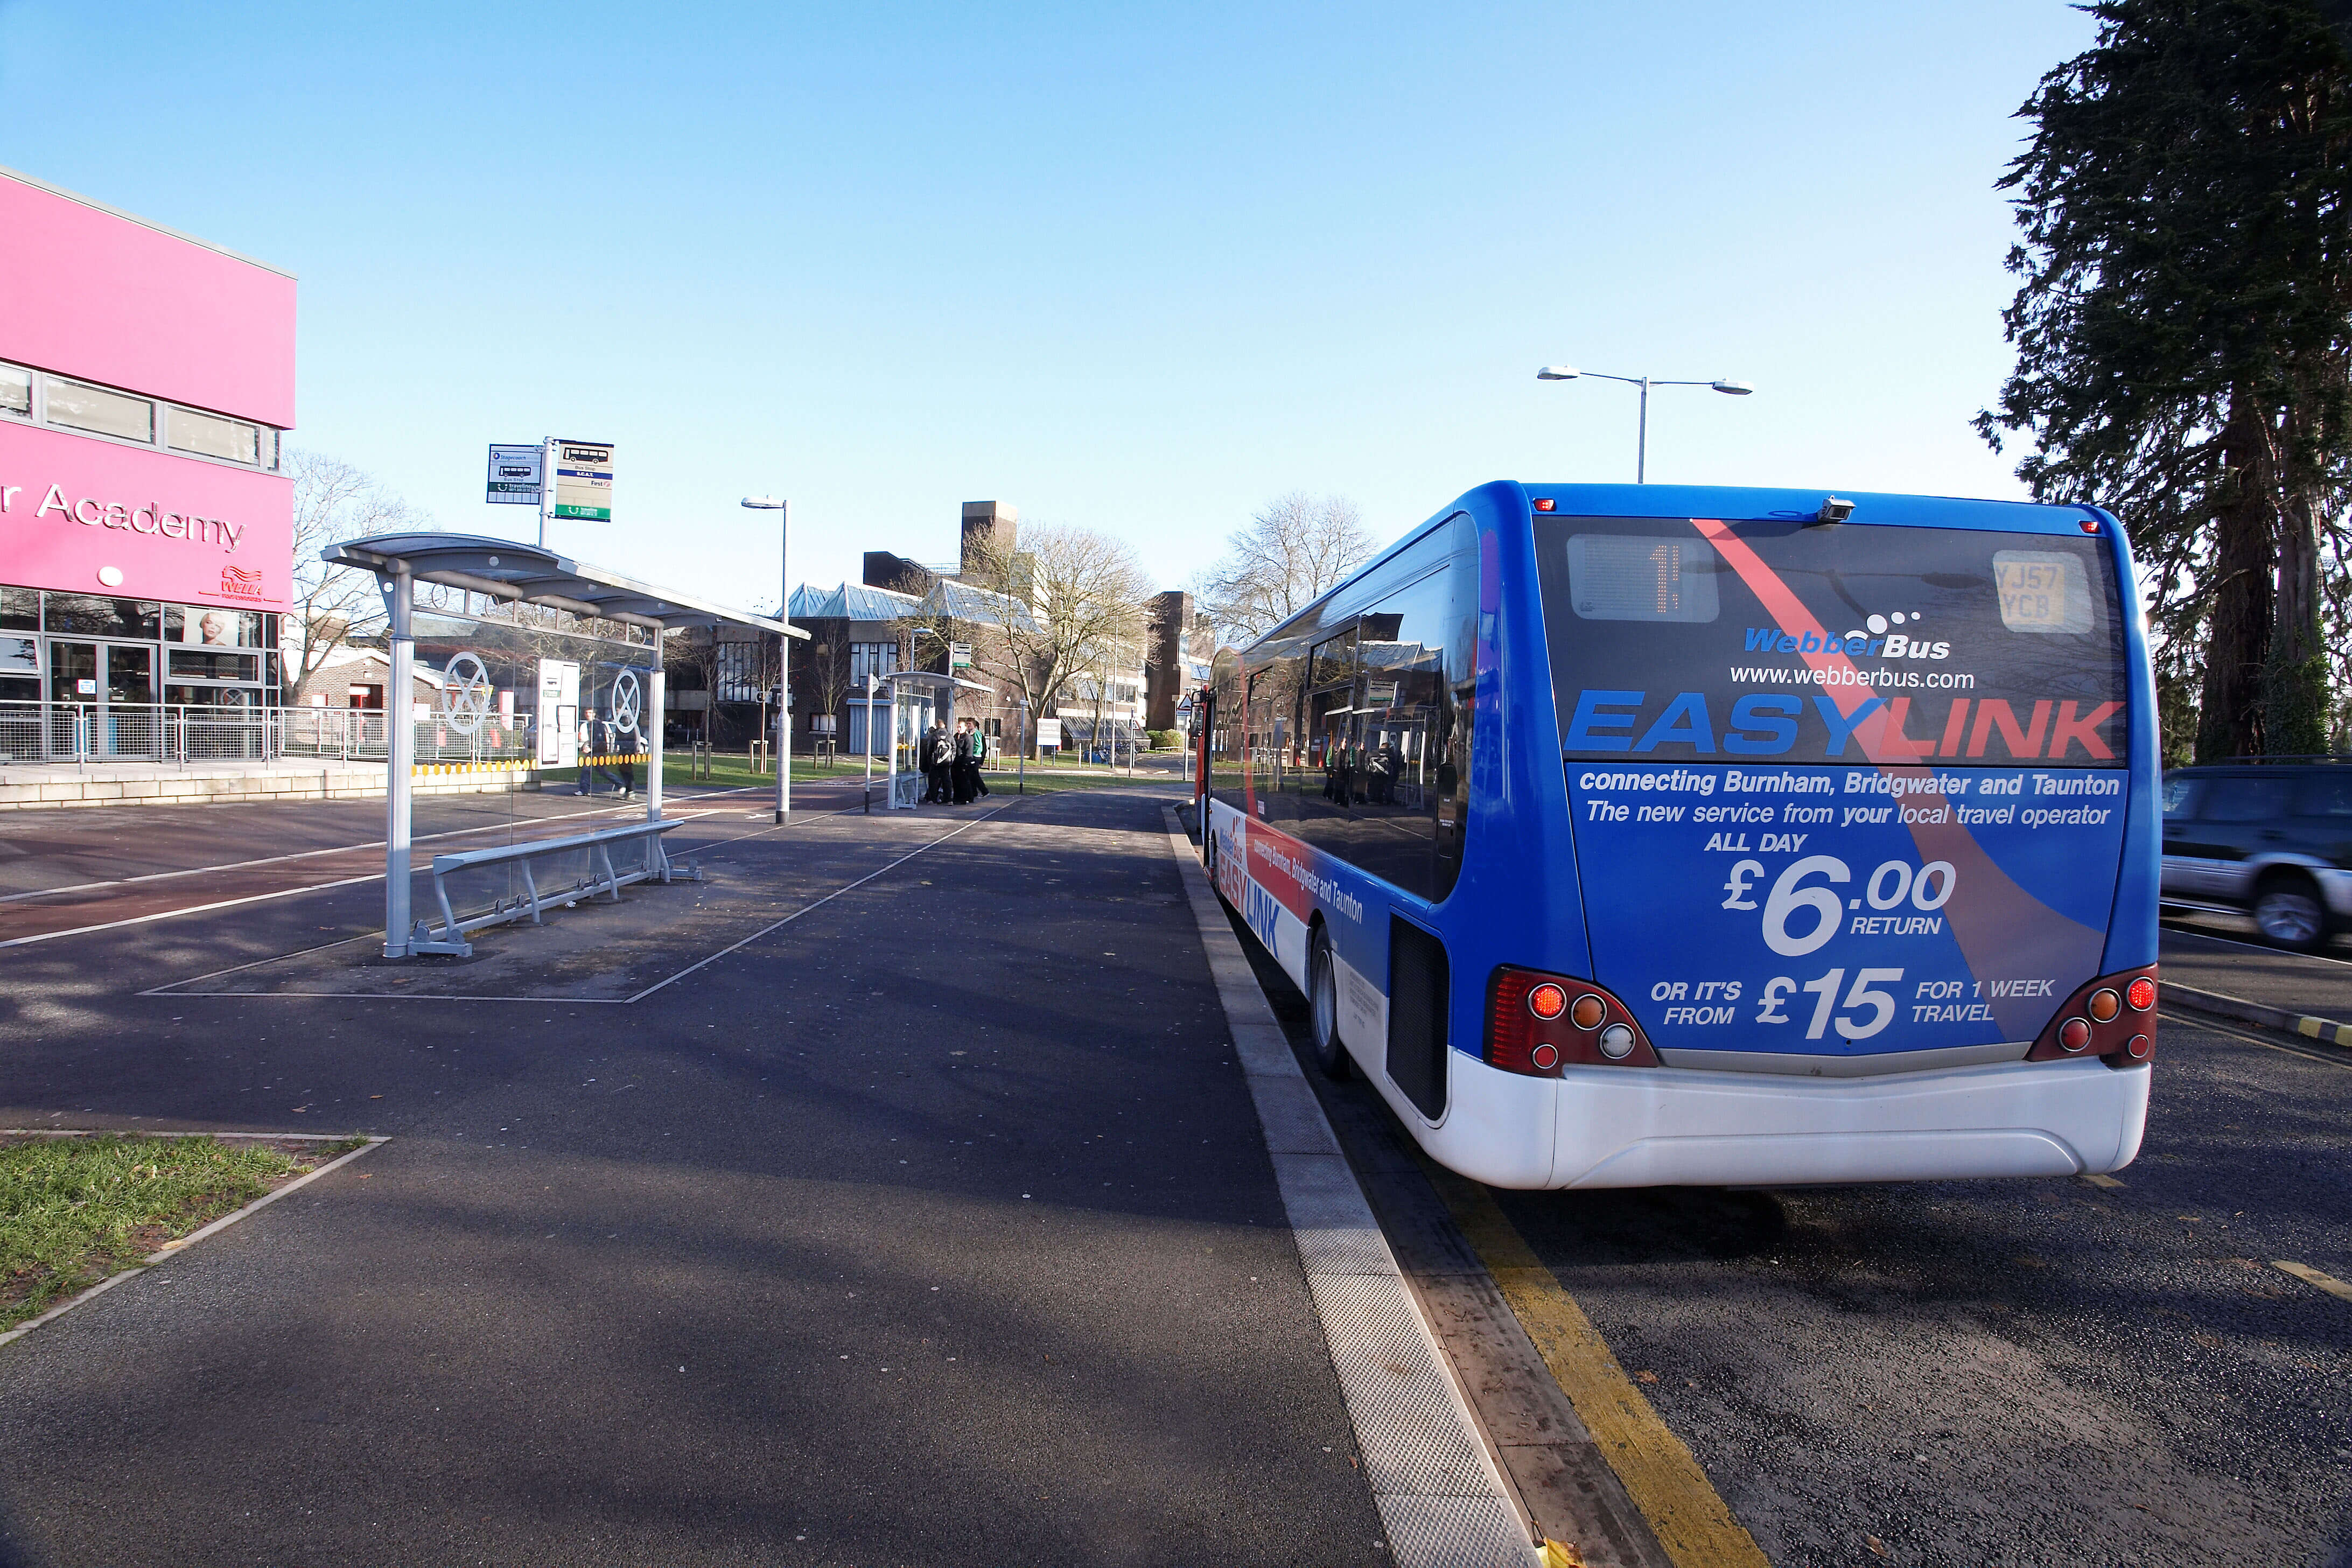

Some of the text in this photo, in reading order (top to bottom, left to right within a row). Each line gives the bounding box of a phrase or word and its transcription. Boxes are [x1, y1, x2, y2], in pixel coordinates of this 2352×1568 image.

[36, 484, 246, 553] Academy
[221, 581, 262, 595] WELLA
[1995, 565, 2058, 590] YJ57
[1730, 666, 1975, 689] www.webberbus.com
[1579, 769, 2119, 798] connecting Burnham, Bridgwater and Taunton
[1586, 800, 2111, 829] The new service from your local travel operator
[1704, 832, 1809, 852] ALL DAY
[1272, 845, 1291, 880] Burnham,
[1292, 857, 1320, 895] Bridgwater
[1319, 879, 1333, 904] and
[1333, 881, 1363, 925] Taunton
[1721, 855, 1957, 957] £6.00
[1850, 916, 1942, 935] RETURN
[1651, 981, 1742, 1001] OR IT'S
[1915, 979, 2056, 999] FOR 1 WEEK
[1663, 1006, 1735, 1025] FROM
[1755, 968, 1905, 1040] £15
[1912, 1004, 1995, 1023] TRAVEL
